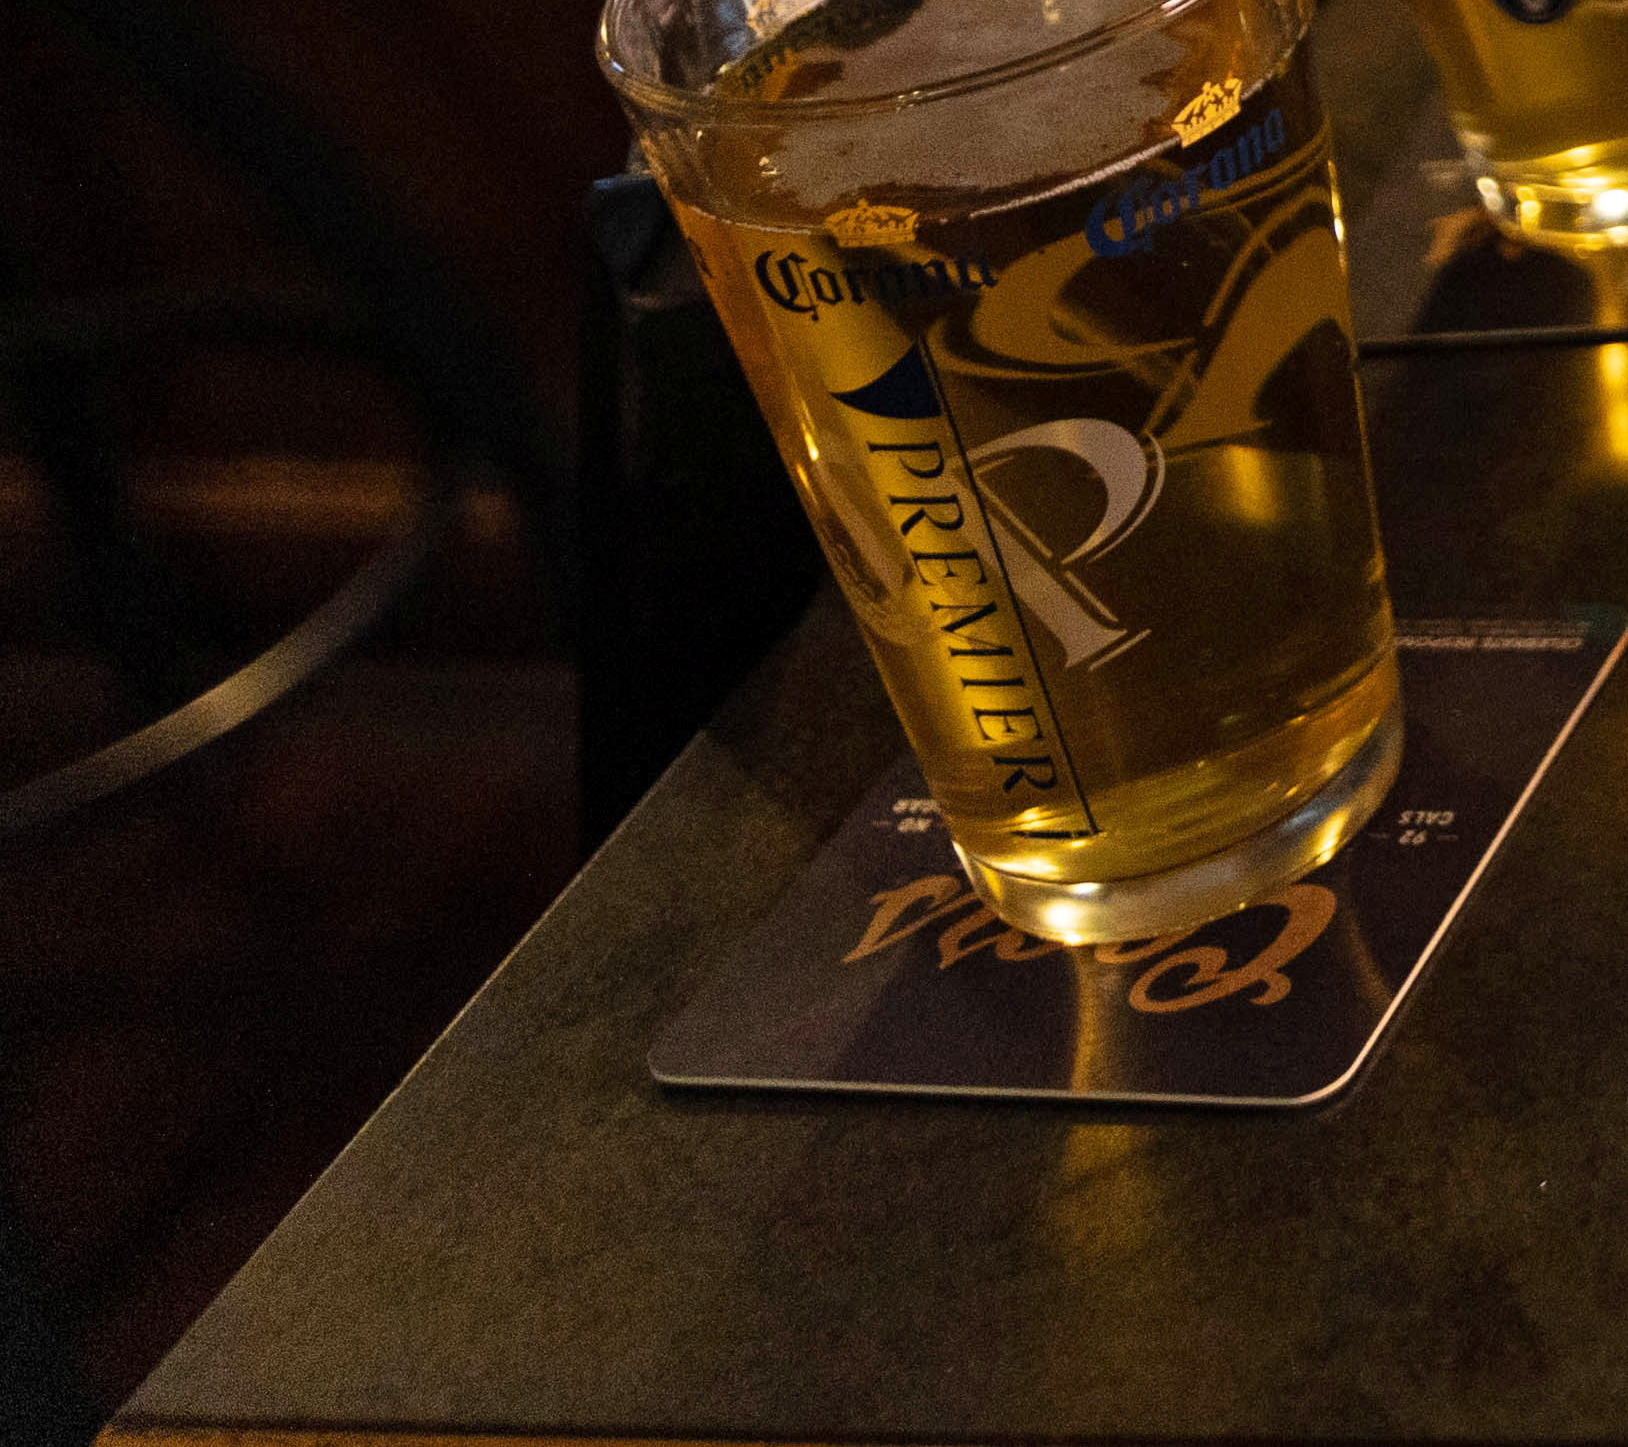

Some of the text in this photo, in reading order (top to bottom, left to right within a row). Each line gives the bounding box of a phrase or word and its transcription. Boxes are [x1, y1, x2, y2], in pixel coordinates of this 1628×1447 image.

[1084, 107, 1286, 259] Corona
[753, 248, 1000, 324] Corona
[866, 438, 1060, 796] PREMIER
